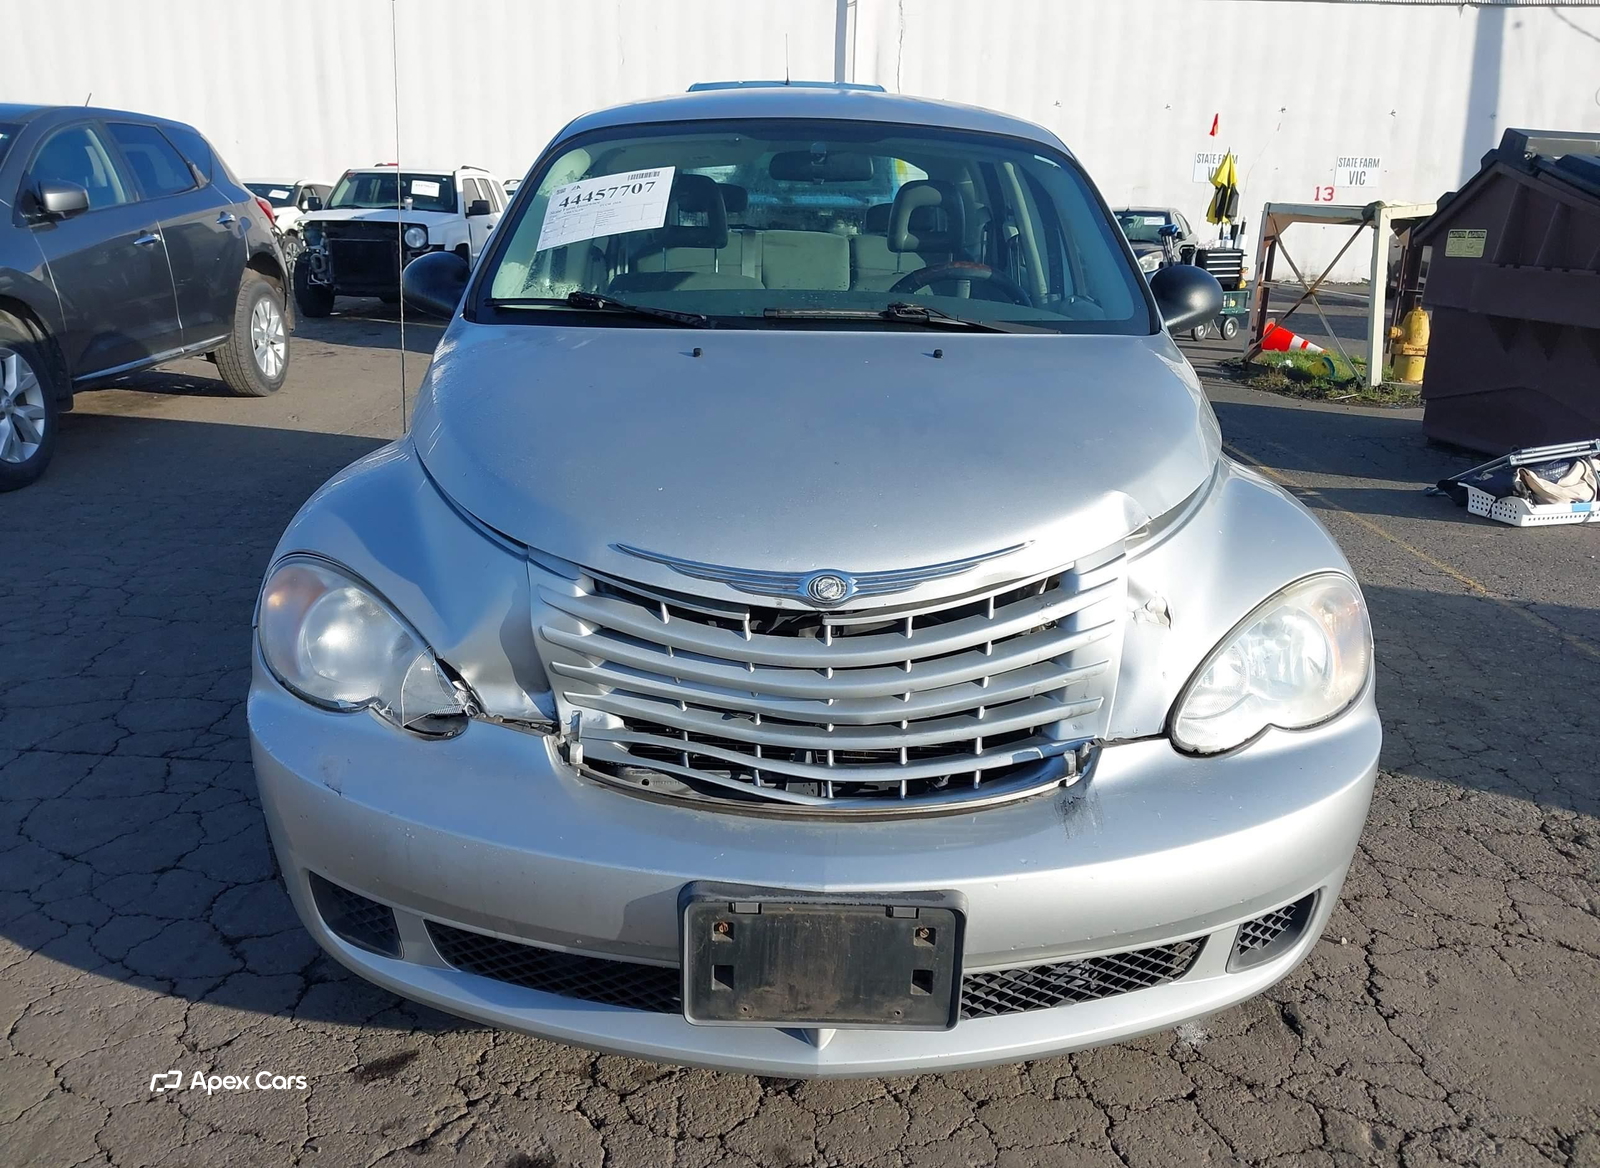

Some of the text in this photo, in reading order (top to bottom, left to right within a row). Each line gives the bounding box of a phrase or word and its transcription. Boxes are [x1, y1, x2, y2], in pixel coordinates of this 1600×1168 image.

[1196, 153, 1217, 164] STATE
[1337, 156, 1380, 169] STATE FARM
[1348, 170, 1366, 186] VIC
[558, 181, 656, 208] 44457707
[1314, 186, 1335, 202] 13
